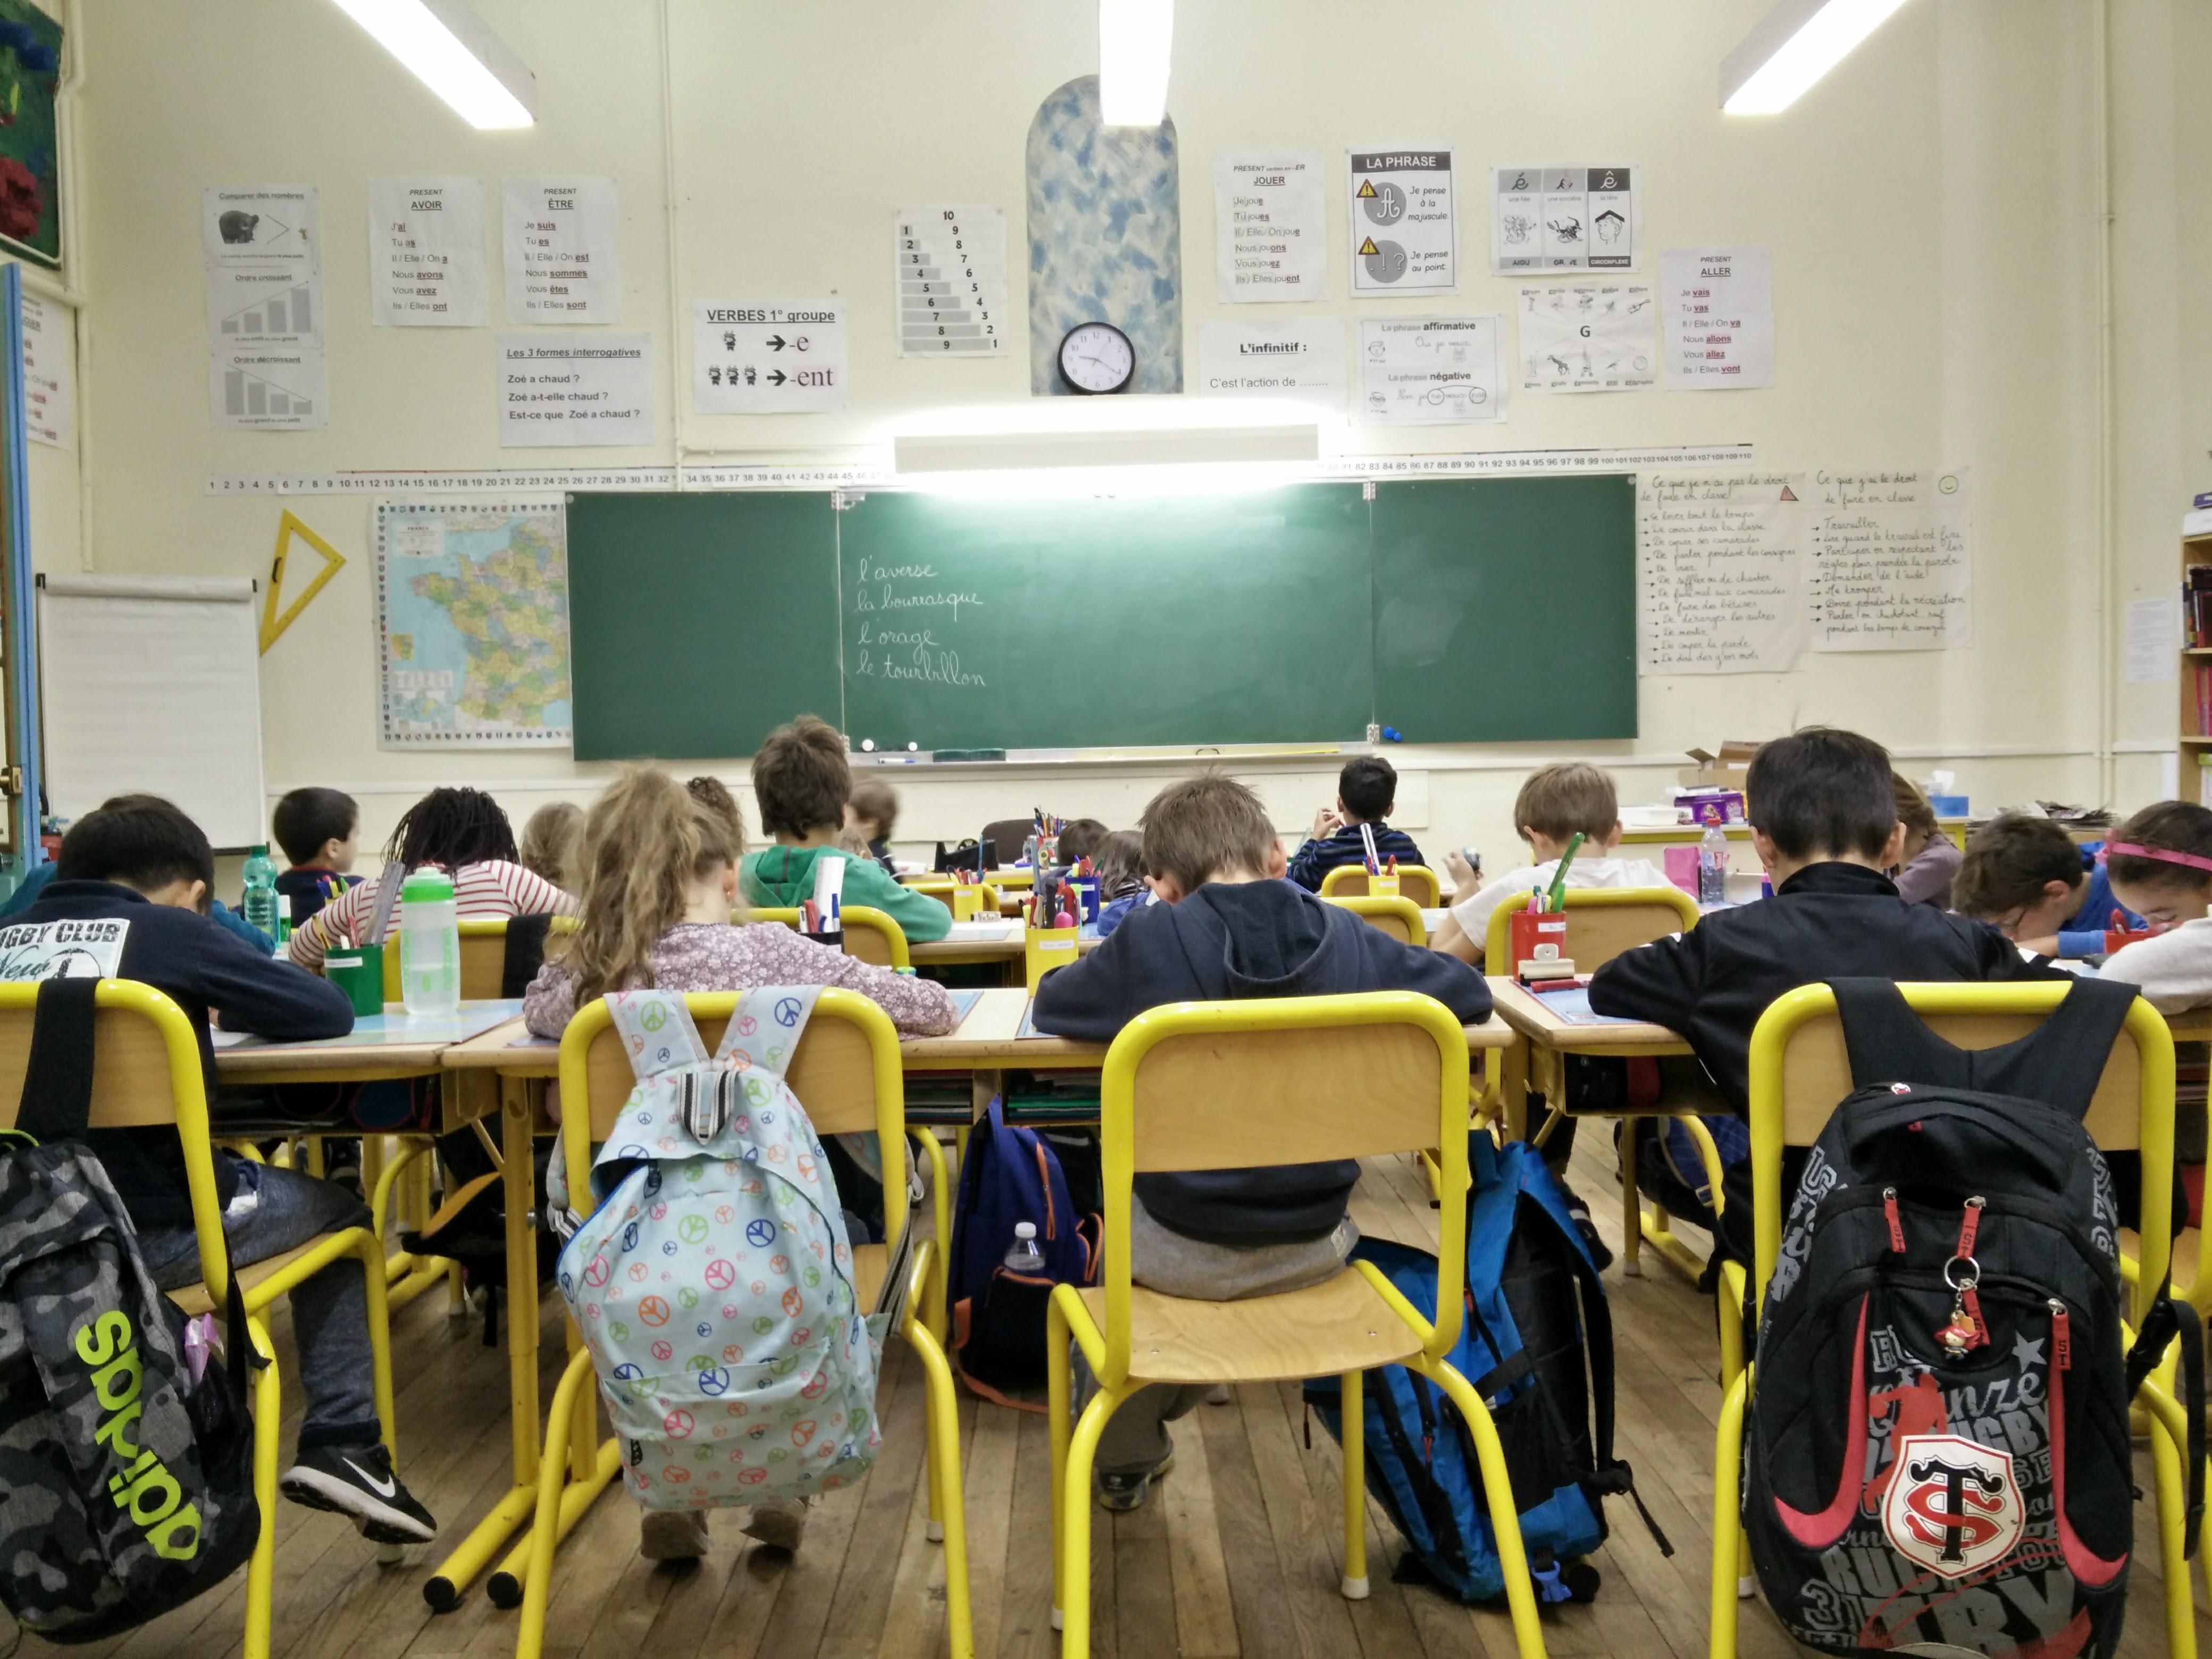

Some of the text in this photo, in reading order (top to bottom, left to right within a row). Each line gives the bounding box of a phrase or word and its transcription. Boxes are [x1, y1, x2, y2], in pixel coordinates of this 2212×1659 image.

[1367, 156, 1437, 169] LA PHRASE
[1410, 186, 1446, 196] Je pense
[411, 200, 442, 209] AVOIR
[548, 198, 574, 208] ÊTRE
[943, 211, 954, 220] 10
[904, 225, 908, 234] 1
[952, 225, 959, 235] 9
[907, 240, 914, 249] 2
[956, 240, 962, 249] 8
[912, 255, 919, 263] 3
[961, 254, 967, 263] 7
[1411, 251, 1448, 260] Je pense
[917, 269, 924, 278] 4
[966, 269, 973, 277] 6
[923, 283, 929, 292] 5
[971, 283, 978, 292] 5
[928, 298, 934, 307] 6
[976, 297, 983, 306] 4
[707, 309, 766, 321] VERBES
[787, 311, 835, 323] groupe
[933, 312, 940, 321] 7
[982, 312, 988, 320] 3
[938, 326, 945, 335] 8
[987, 325, 993, 334] 2
[1423, 322, 1476, 331] affirmative
[1580, 325, 1590, 338] G
[944, 340, 950, 349] 9
[993, 339, 998, 348] 1
[1240, 342, 1299, 354] L'infinitif
[507, 347, 641, 357] Les 3 formes interrogatives
[508, 374, 527, 383] Zoé
[539, 374, 570, 383] chaud
[1400, 374, 1428, 382] phrase
[1430, 372, 1471, 382] négative
[1210, 376, 1296, 388] C'est l'action de
[508, 393, 527, 401] Zoé
[530, 392, 565, 401] a-t-elle
[568, 392, 599, 400] chaud
[509, 410, 541, 420] Est-ce
[544, 412, 564, 421] que
[568, 410, 589, 419] Zoé
[599, 409, 631, 418] chaud
[857, 554, 939, 585] l'averse
[853, 583, 984, 622] la bourrasque
[858, 618, 939, 665] l'orage
[856, 649, 986, 686] le tourbillon
[55, 923, 120, 943] CLUB
